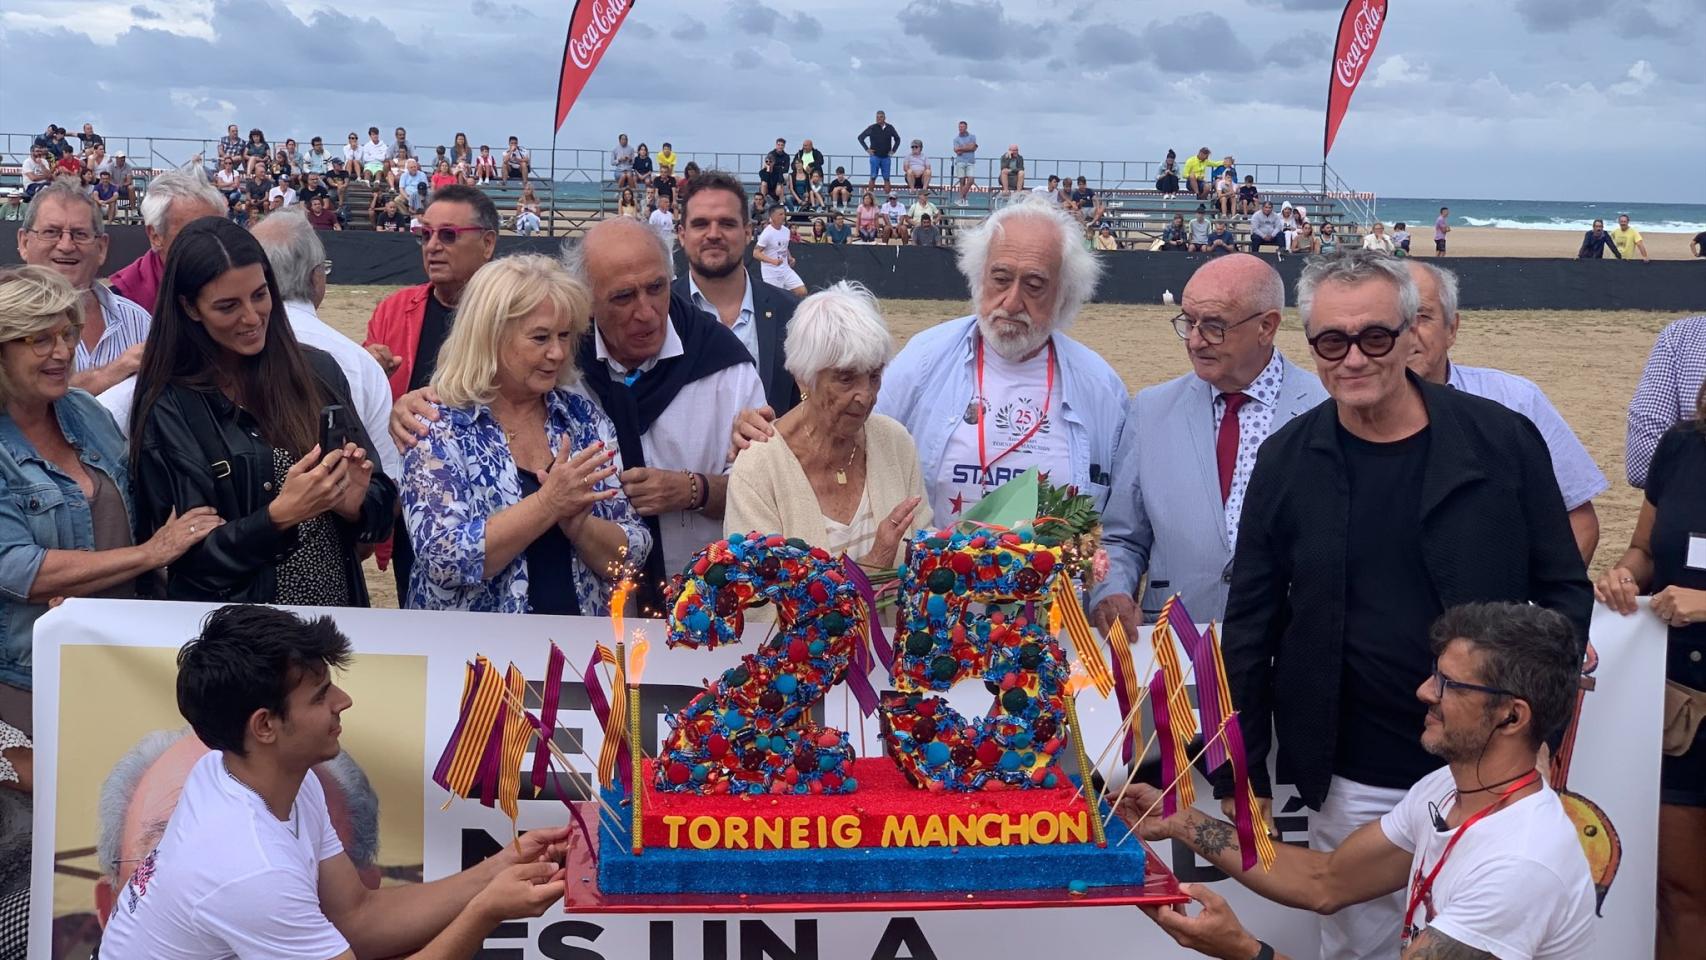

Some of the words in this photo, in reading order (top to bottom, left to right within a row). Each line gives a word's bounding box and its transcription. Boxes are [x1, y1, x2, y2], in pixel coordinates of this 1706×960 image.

[1015, 409, 1032, 425] 25
[662, 814, 862, 849] TORNEIG
[881, 811, 1088, 847] MANCHON
